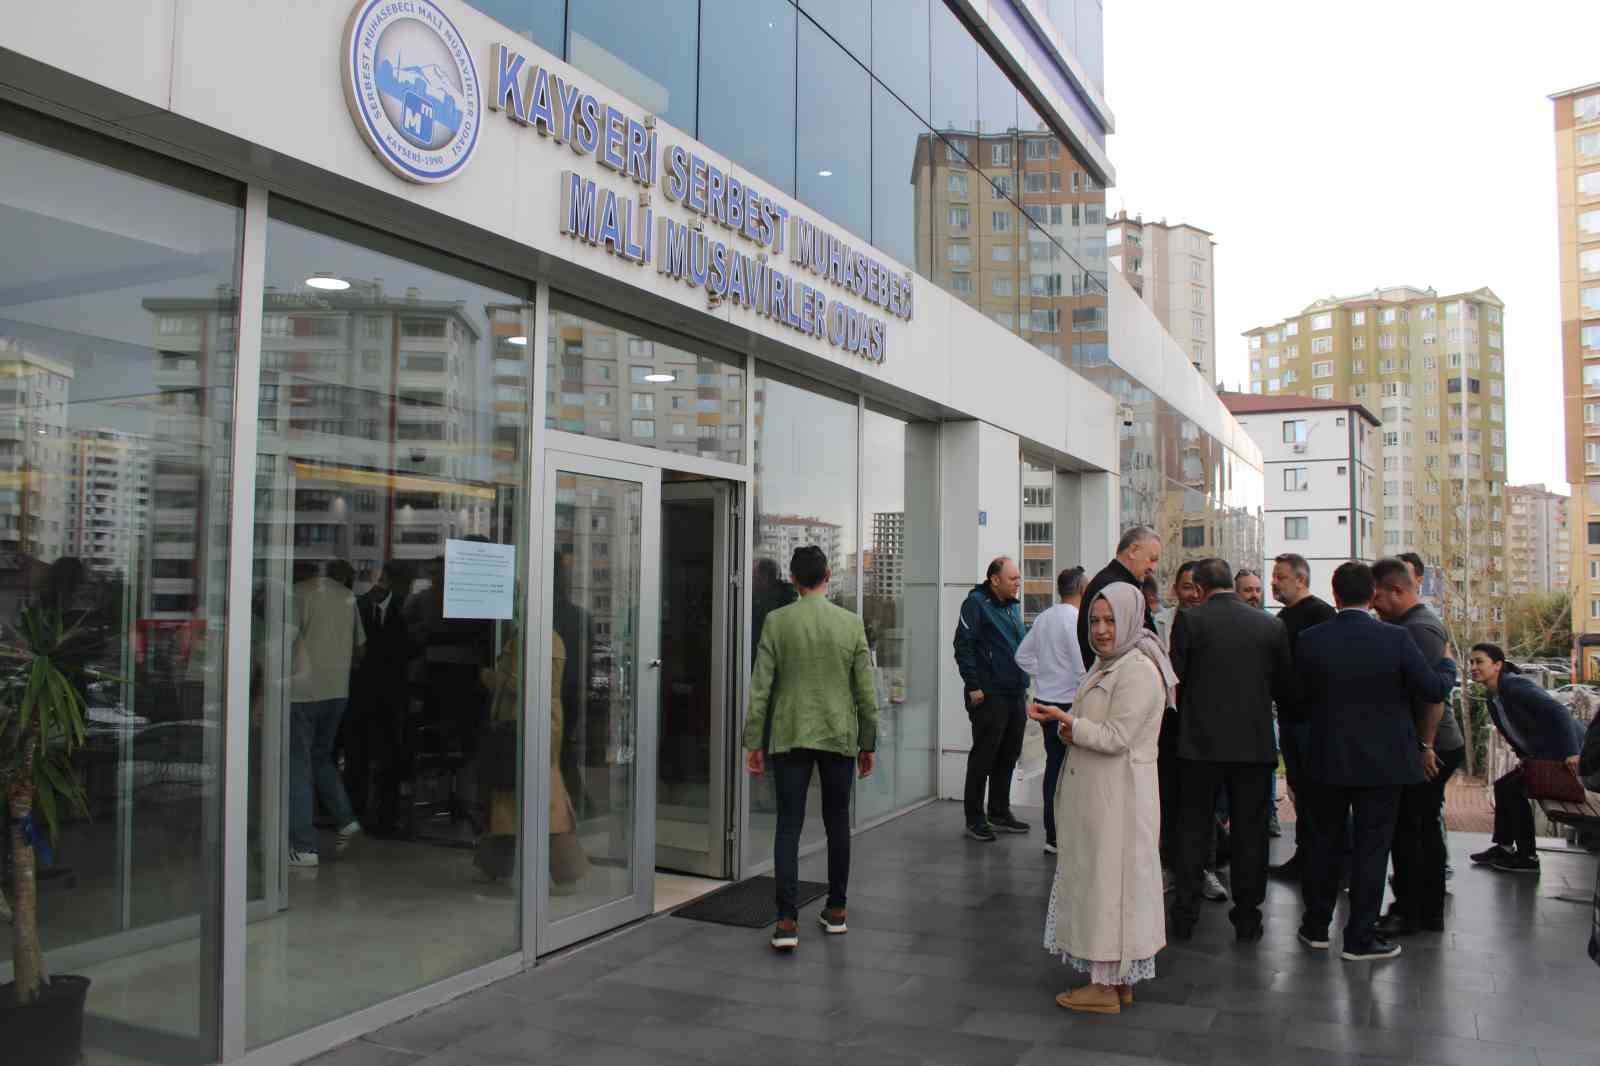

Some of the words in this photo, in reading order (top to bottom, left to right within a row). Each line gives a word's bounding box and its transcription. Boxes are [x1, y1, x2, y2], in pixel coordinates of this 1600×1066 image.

[489, 42, 658, 188] KAYSERİ
[662, 144, 789, 255] SERBEST
[561, 170, 655, 266] MALİ
[828, 299, 887, 366] ODASI
